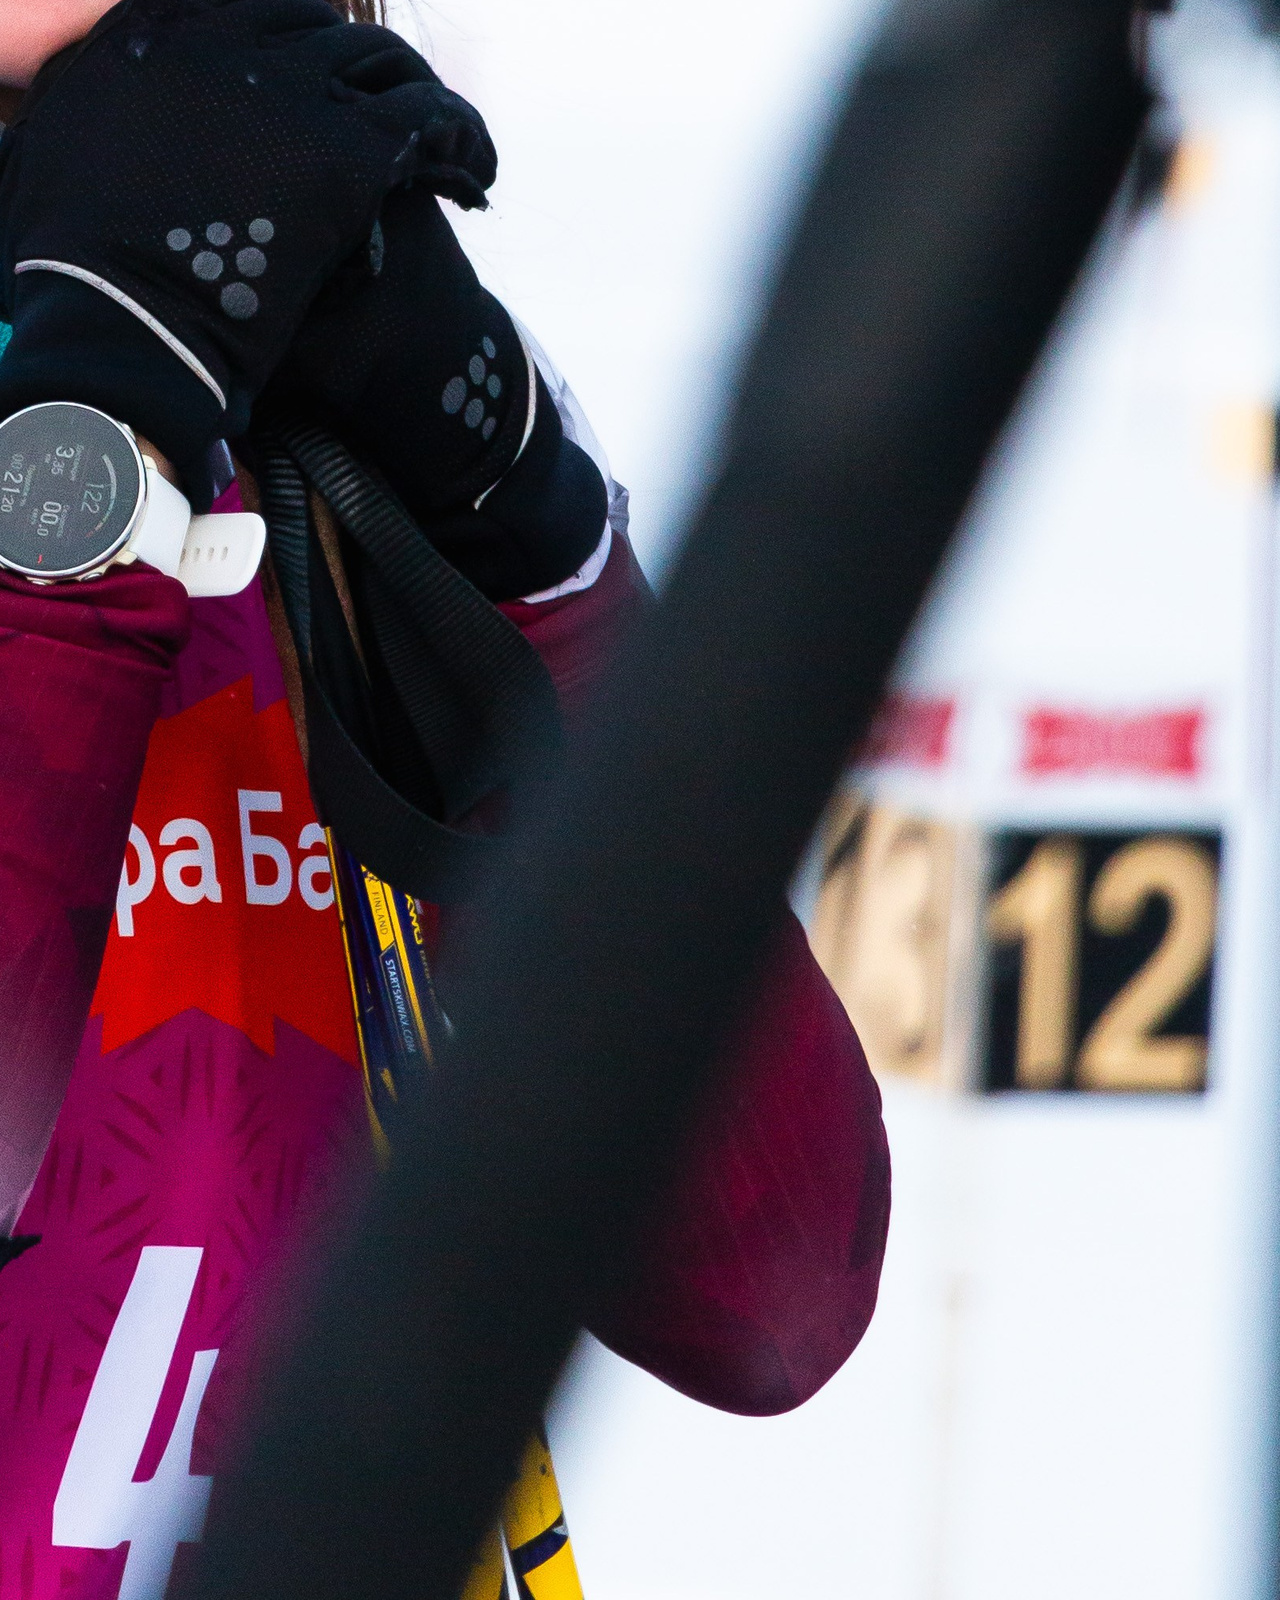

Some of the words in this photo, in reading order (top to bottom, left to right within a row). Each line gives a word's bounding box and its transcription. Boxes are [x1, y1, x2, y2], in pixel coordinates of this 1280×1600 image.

[36, 501, 62, 536] 00.0
[81, 483, 105, 514] 122
[371, 891, 388, 935] FINLAND
[985, 832, 1220, 1092] 12
[384, 958, 417, 1053] STARTSKIWAX.COM
[51, 1245, 220, 1600] 4
